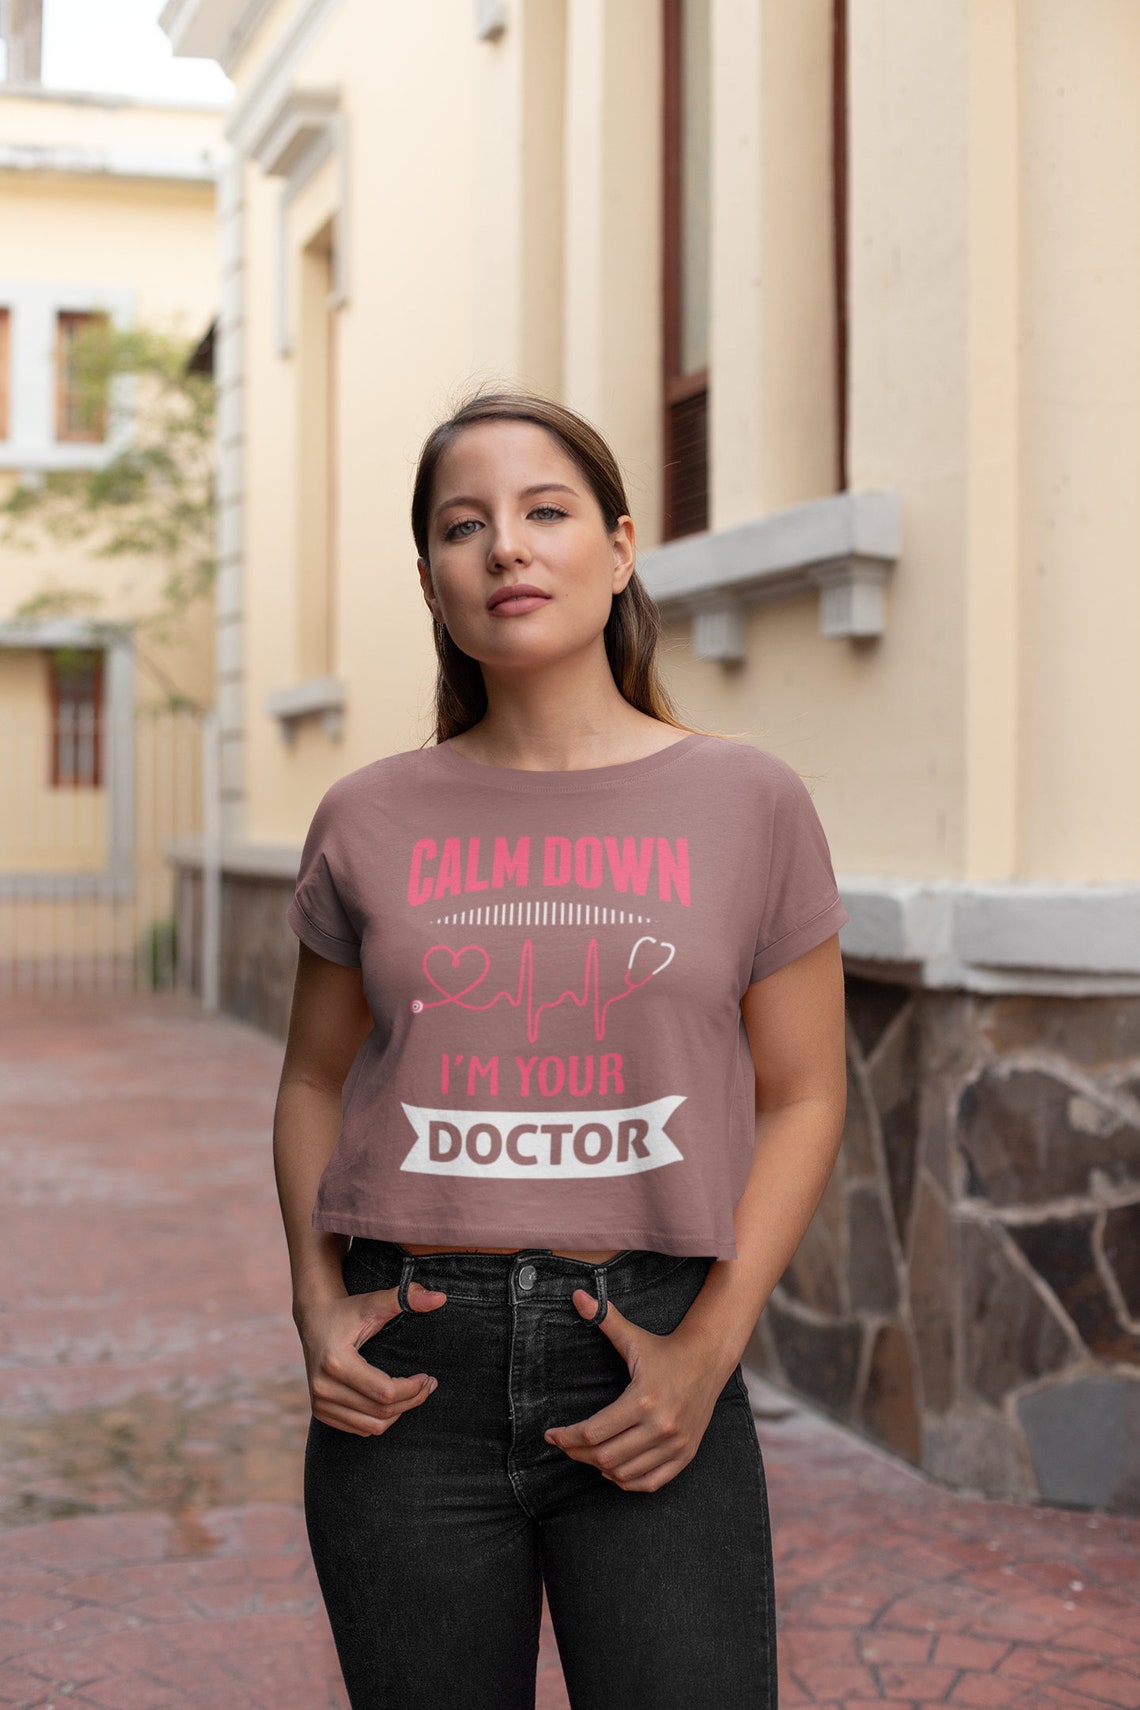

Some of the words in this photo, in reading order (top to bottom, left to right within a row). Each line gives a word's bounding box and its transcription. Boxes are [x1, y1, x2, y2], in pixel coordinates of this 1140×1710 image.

[407, 836, 531, 907] CALM
[542, 836, 692, 908] DOWN
[441, 1053, 499, 1097] I'M
[515, 1052, 625, 1097] YOUR
[429, 1118, 651, 1166] DOCTOR
